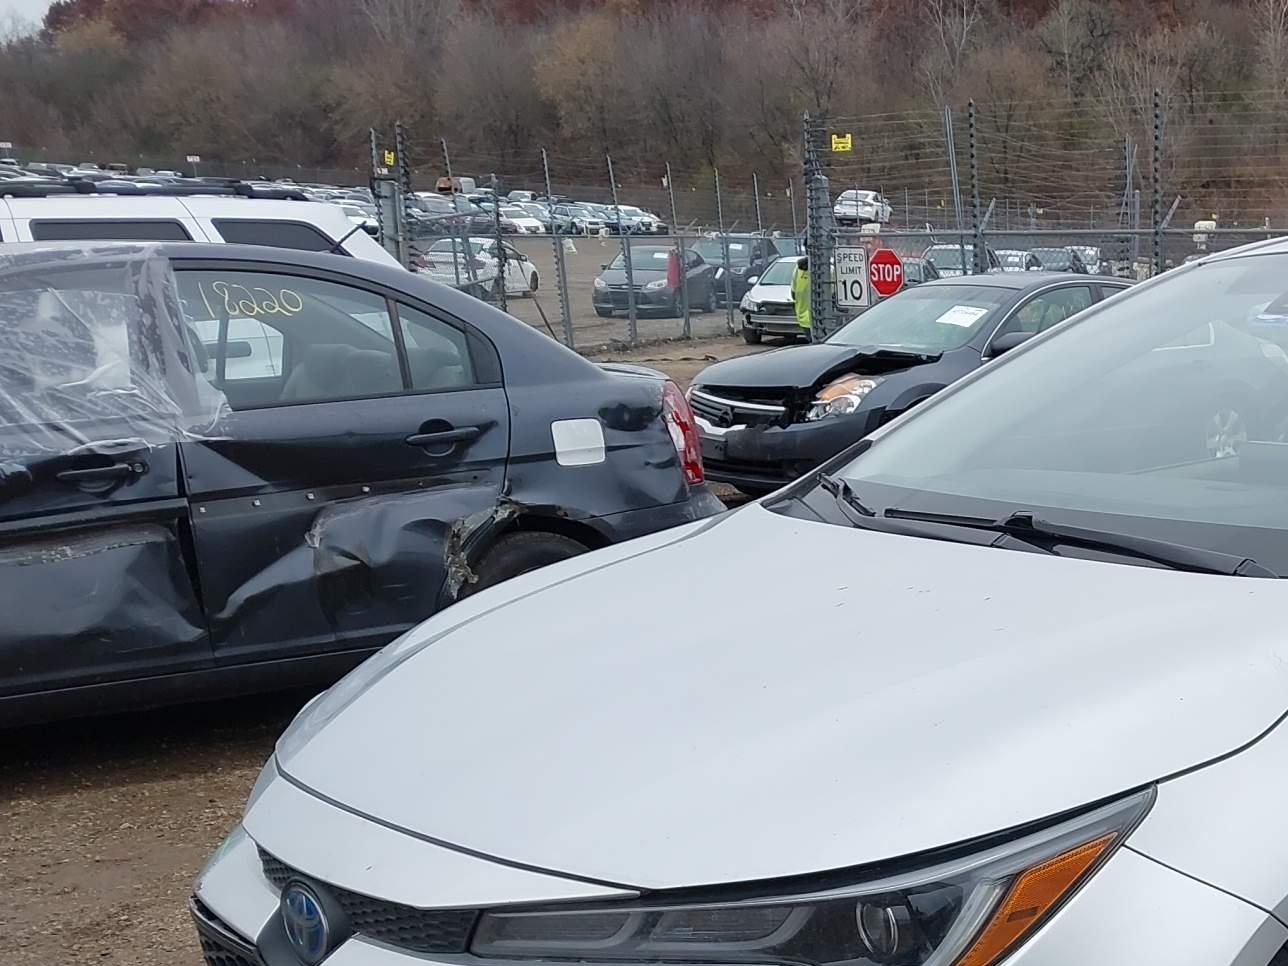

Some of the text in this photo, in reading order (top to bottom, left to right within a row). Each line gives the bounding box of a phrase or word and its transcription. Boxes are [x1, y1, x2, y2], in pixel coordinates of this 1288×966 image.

[837, 253, 864, 263] SPEED
[840, 266, 862, 275] LIMIT
[871, 264, 901, 282] STOP
[842, 279, 863, 301] 10
